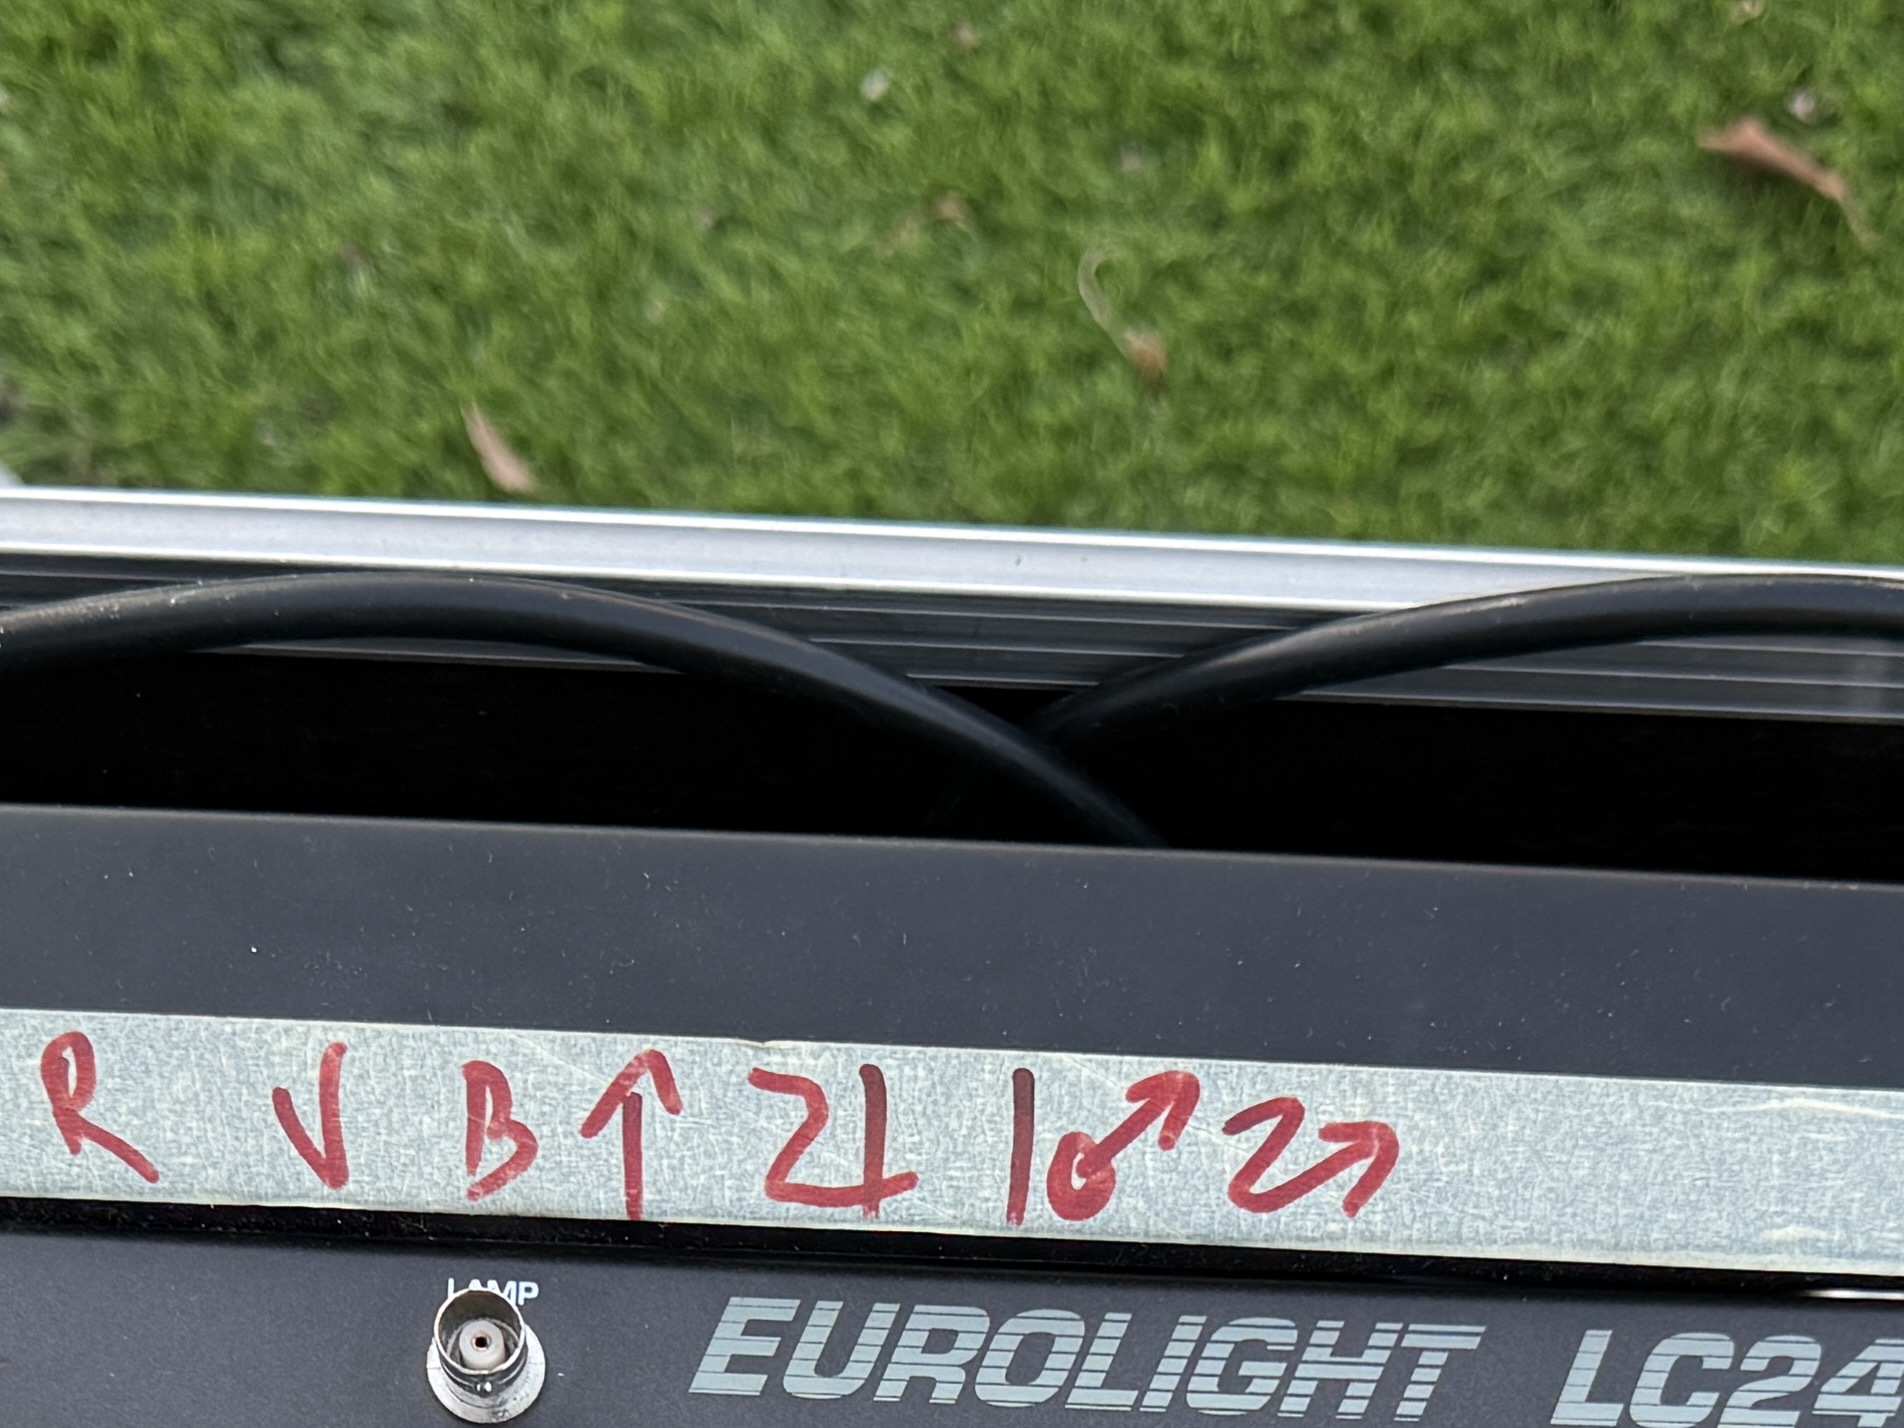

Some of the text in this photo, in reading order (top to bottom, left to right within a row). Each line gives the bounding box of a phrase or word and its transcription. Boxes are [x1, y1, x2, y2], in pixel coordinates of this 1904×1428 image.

[39, 1031, 160, 1184] R
[462, 1058, 539, 1202] B
[688, 1296, 1486, 1422] EUROLIGHT
